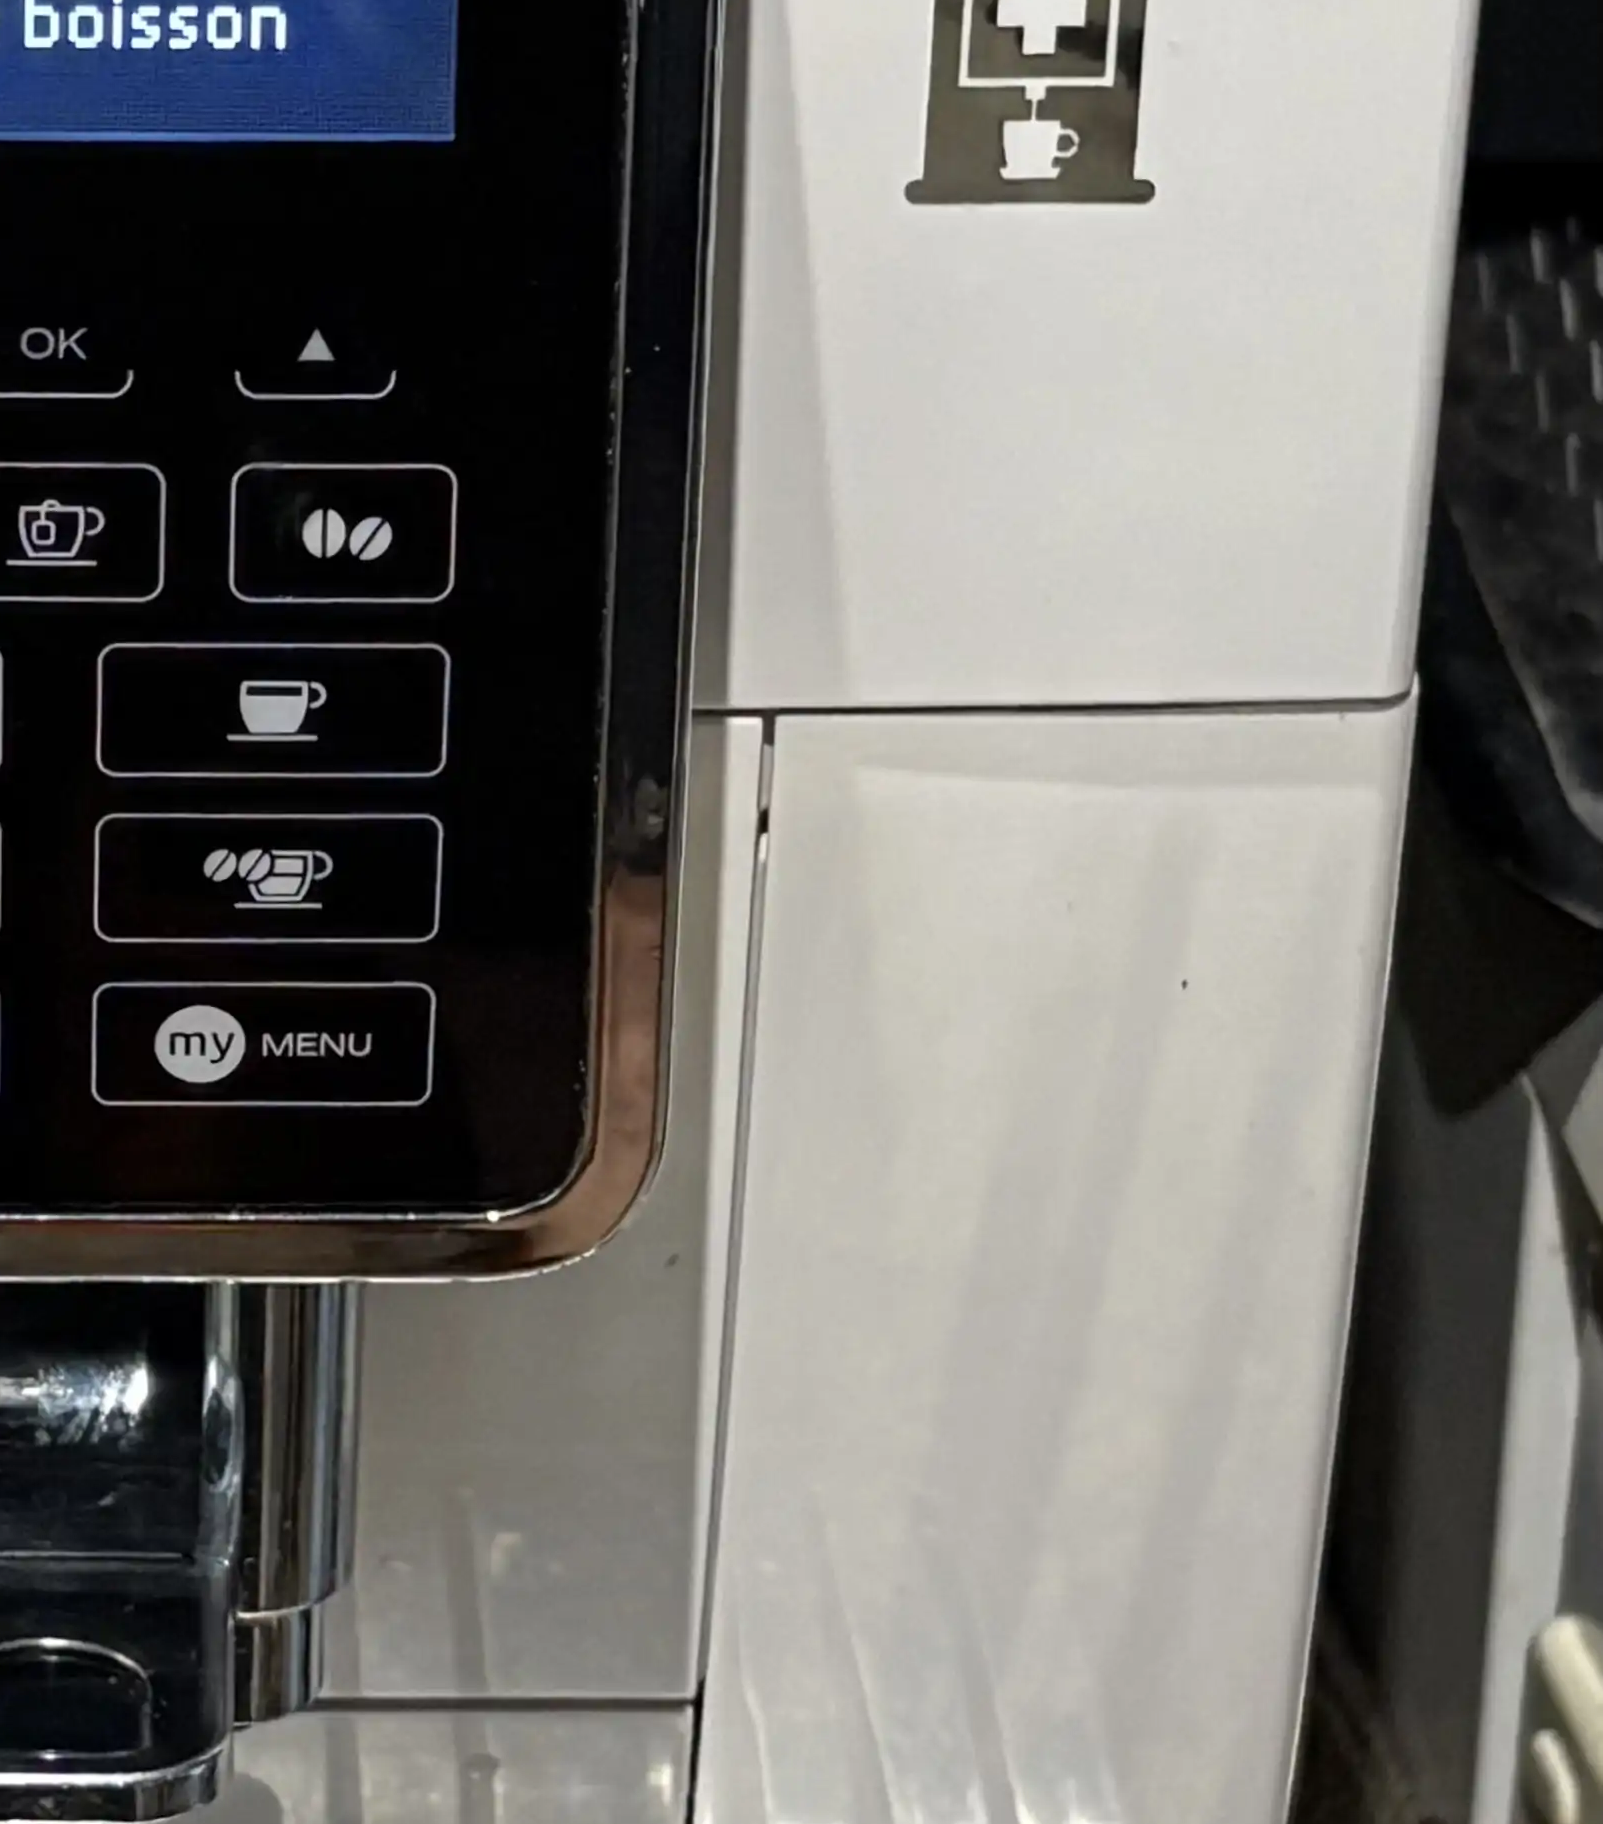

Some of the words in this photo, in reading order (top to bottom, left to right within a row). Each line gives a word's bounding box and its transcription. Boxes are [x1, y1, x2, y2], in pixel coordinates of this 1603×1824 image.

[20, 327, 88, 360] OK
[168, 1029, 236, 1065] my
[261, 1032, 373, 1057] MENU
